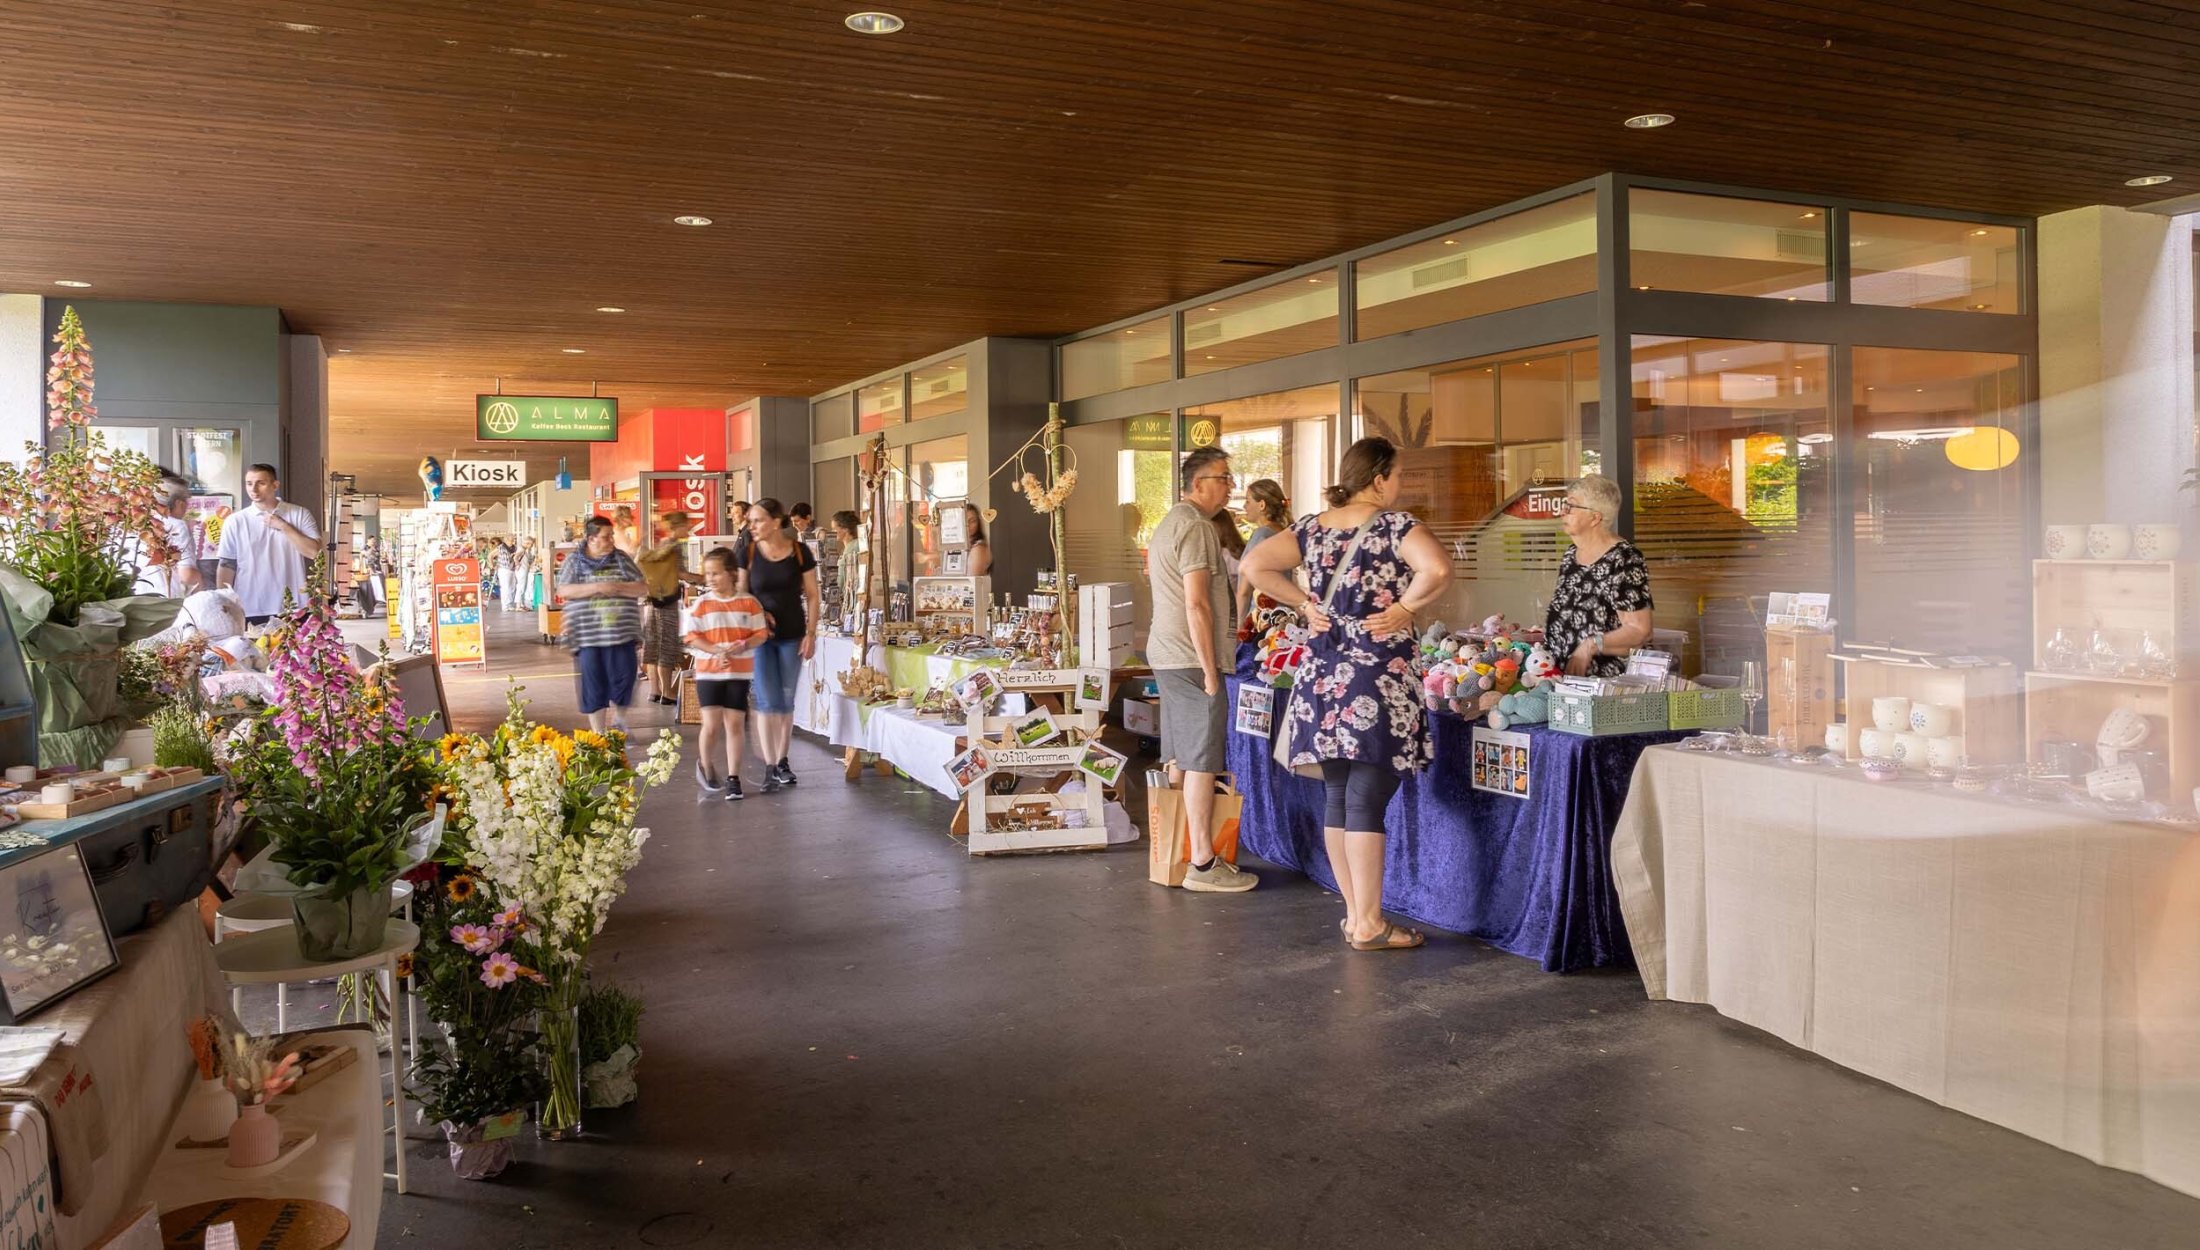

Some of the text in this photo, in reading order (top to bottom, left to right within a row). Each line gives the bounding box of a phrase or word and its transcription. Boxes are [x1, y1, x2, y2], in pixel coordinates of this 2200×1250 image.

[531, 406, 610, 420] ALMA
[453, 464, 519, 481] Kiosk
[996, 671, 1056, 684] Herzlich
[994, 751, 1071, 764] Willkommen
